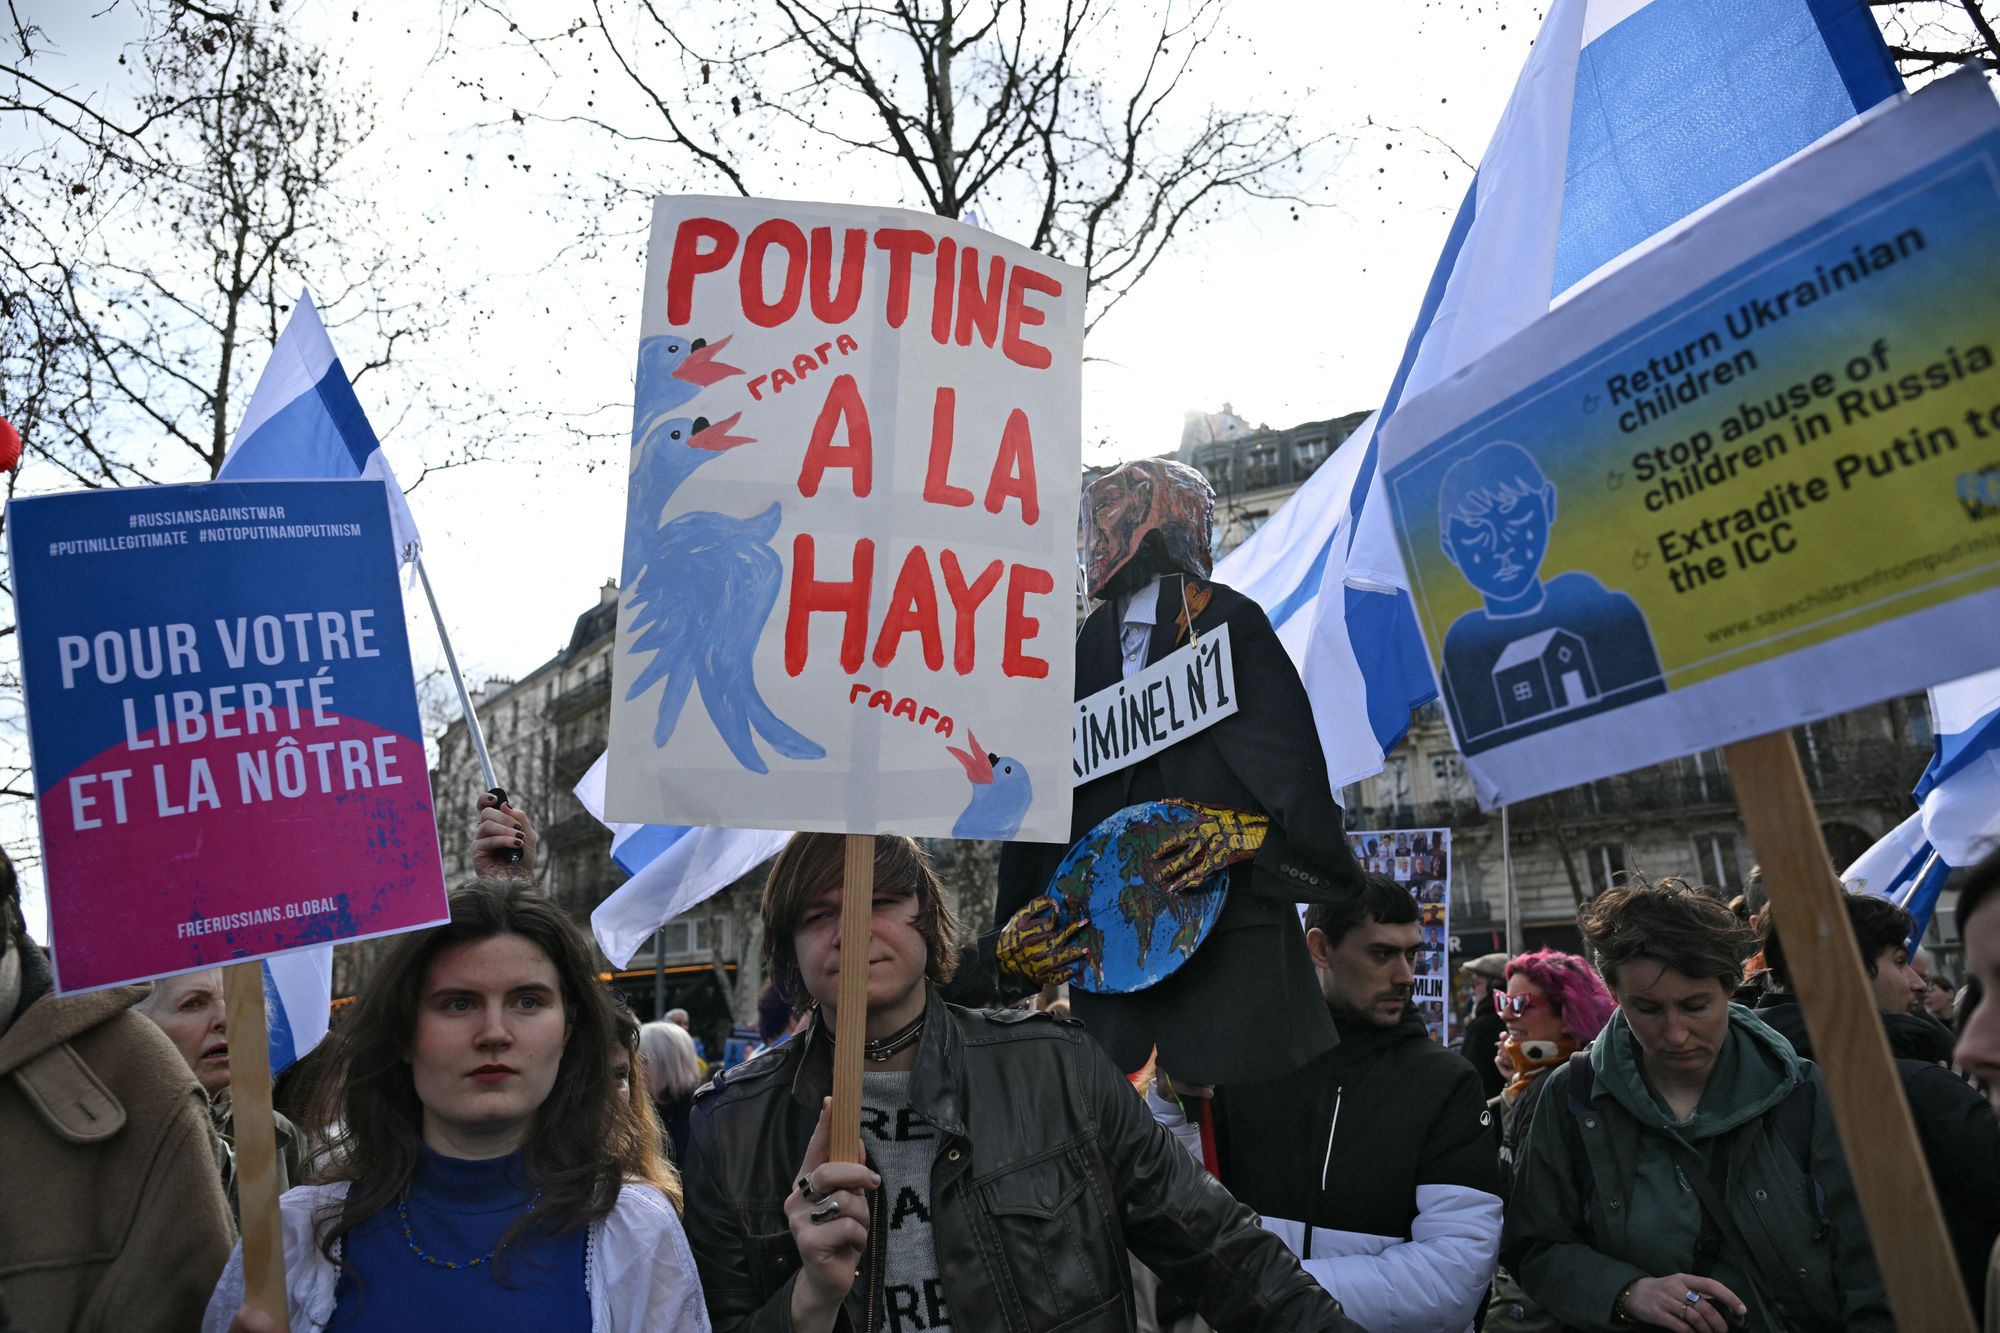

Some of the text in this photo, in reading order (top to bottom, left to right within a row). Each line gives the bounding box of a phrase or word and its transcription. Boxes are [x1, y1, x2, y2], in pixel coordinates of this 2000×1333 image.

[666, 217, 1062, 370] POUTINE
[1606, 227, 1926, 406] Return Ukrainian
[1618, 348, 1758, 433] children
[1631, 338, 1890, 482] Stop abuse of
[1644, 345, 1994, 512] children in Russia
[797, 374, 1040, 526] A LA
[1657, 476, 1829, 564] Extradite
[1834, 426, 1958, 490] Putin
[50, 523, 361, 556] #PUTINILLEGITIMATE #NOTOPUTINANDPUTINISM
[129, 506, 285, 528] #RUSSIANSAGAINSTWAR
[1668, 521, 1797, 593] the ICC
[58, 609, 380, 689] POUR VOTRE
[784, 533, 1054, 678] HAYE
[123, 666, 340, 751] LIBERTÉ
[69, 735, 403, 831] ET LA NÔTRE
[177, 897, 338, 939] FREERUSSIANS.GLOBAL
